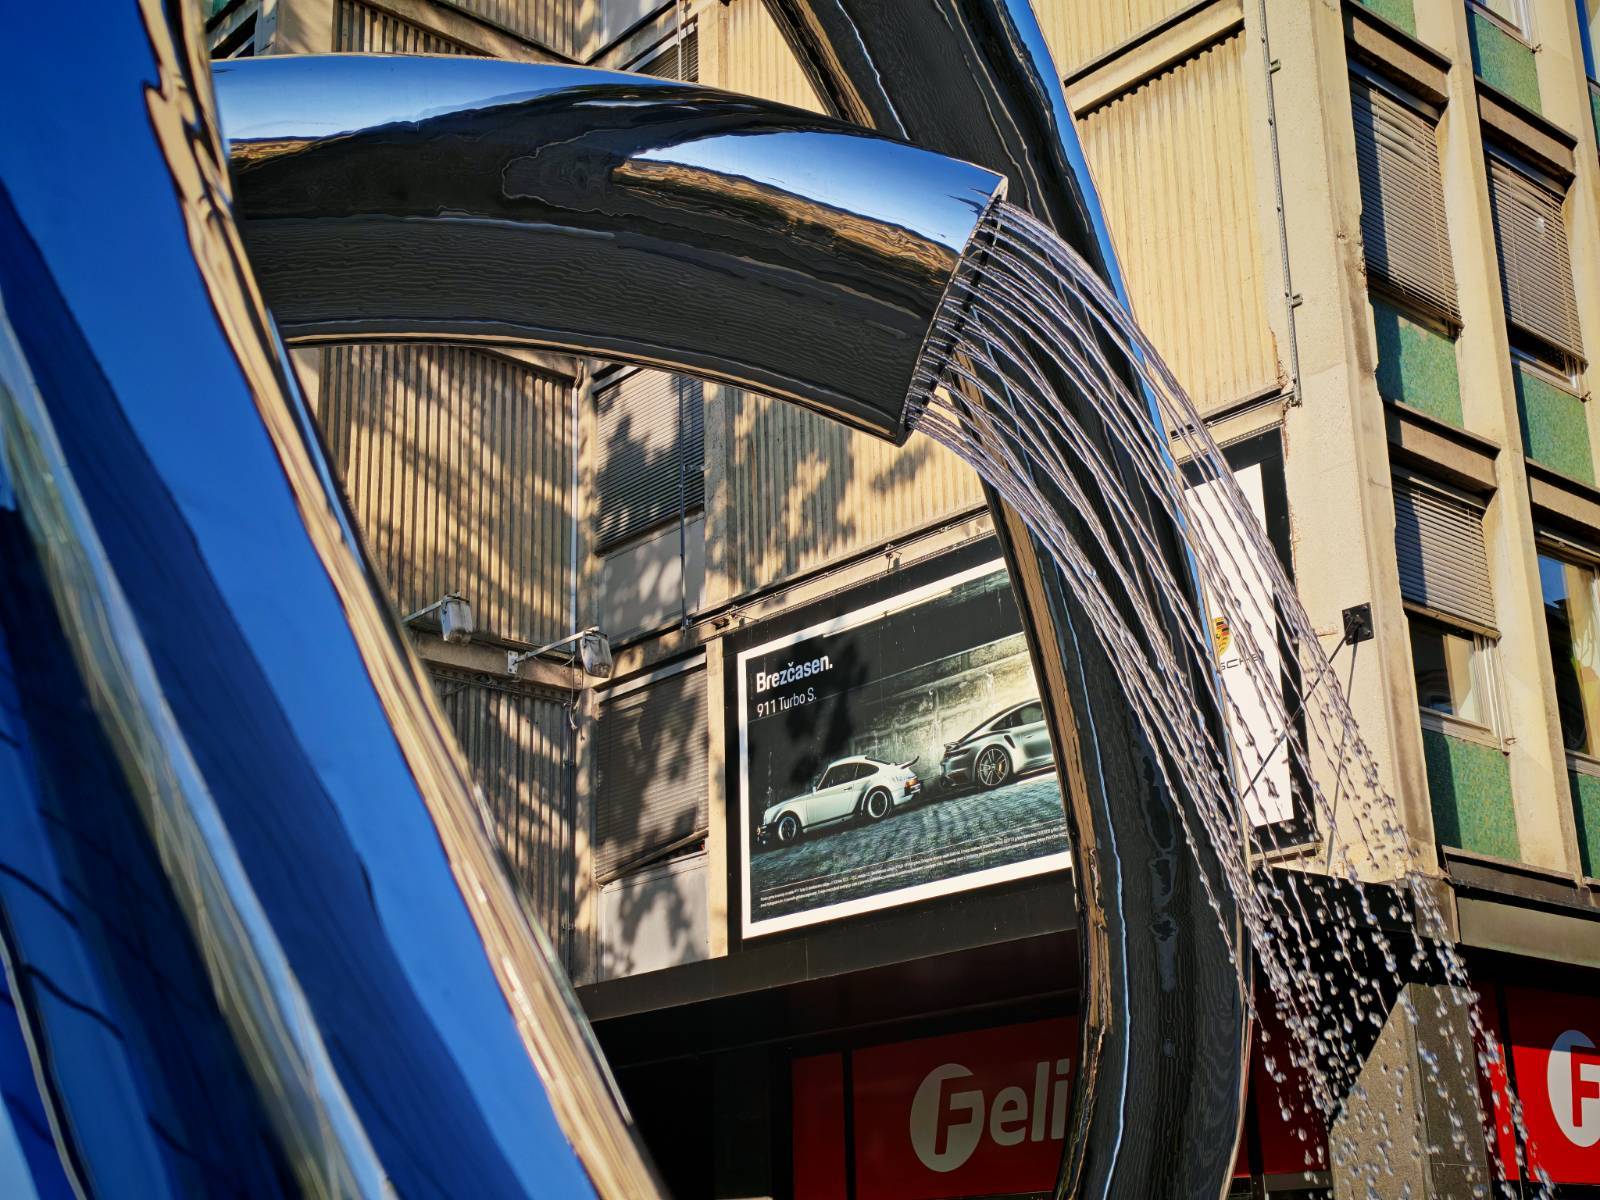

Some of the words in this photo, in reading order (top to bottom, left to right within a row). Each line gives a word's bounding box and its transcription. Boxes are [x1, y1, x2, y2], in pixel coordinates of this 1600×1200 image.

[756, 655, 833, 693] Brezčasen.
[757, 699, 776, 718] 911
[778, 693, 806, 711] Turbo
[807, 687, 817, 702] S.
[910, 1058, 1070, 1173] Feli
